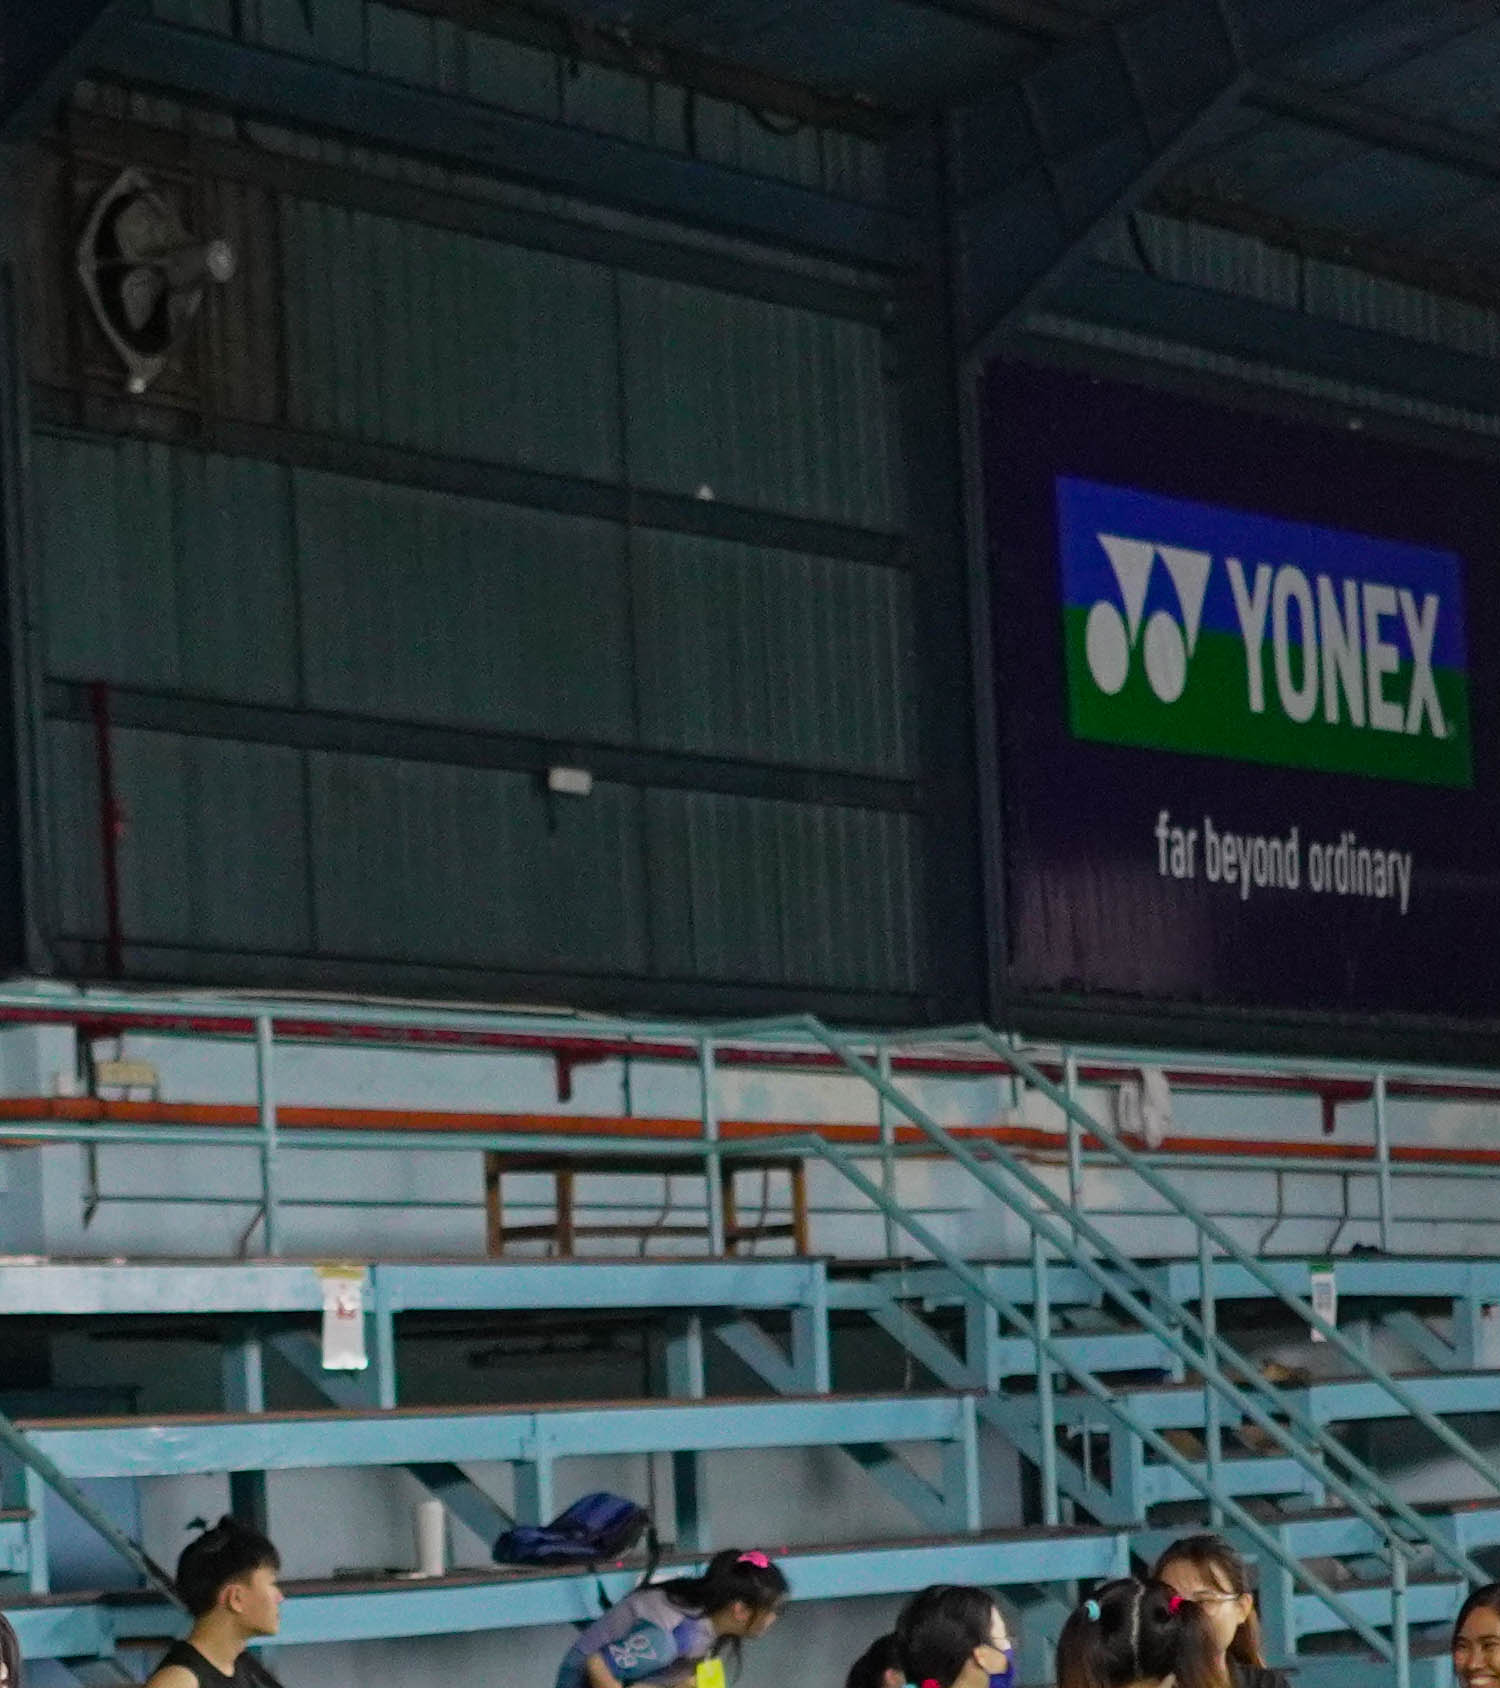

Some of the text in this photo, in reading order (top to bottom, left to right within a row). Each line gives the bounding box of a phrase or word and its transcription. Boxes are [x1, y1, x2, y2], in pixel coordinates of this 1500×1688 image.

[1224, 556, 1449, 739] YONEX
[1154, 808, 1413, 916] far beyond ordinary
